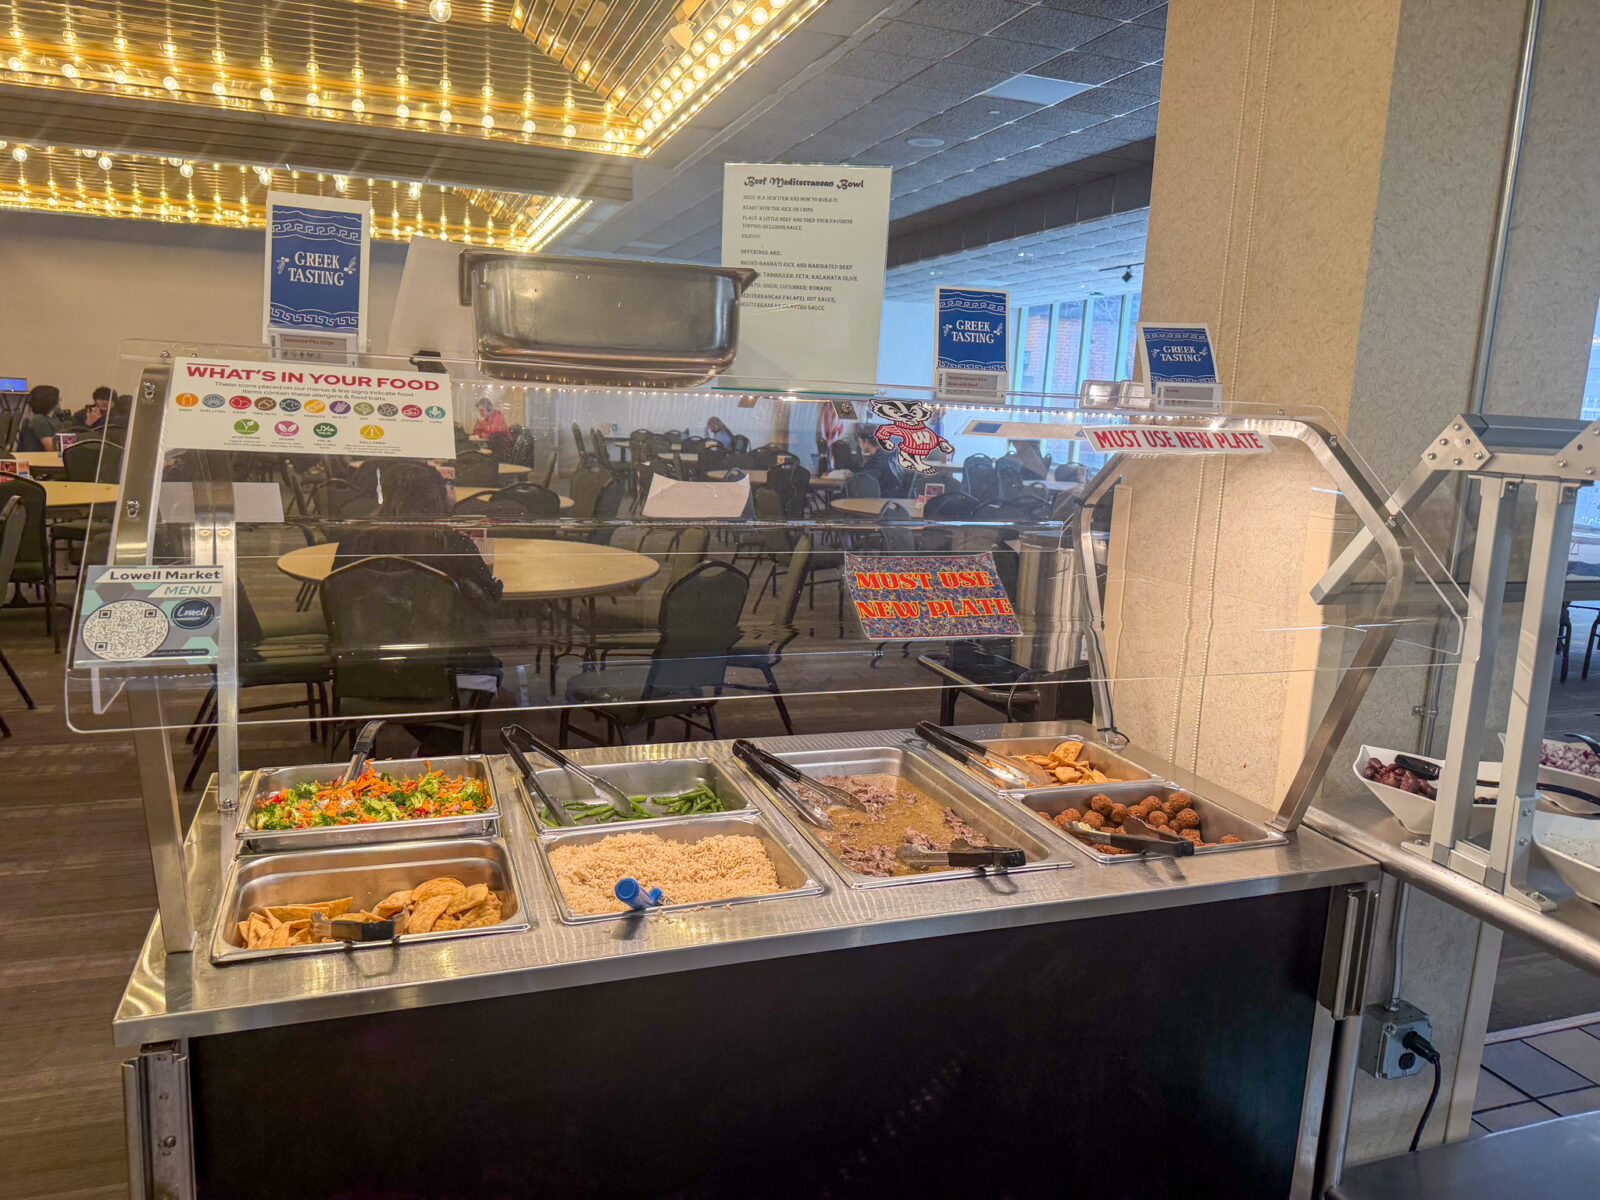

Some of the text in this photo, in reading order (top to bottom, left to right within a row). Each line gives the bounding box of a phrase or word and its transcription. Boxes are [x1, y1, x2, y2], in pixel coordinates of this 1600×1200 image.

[744, 176, 864, 190] Beef Mediterranean Bowl
[294, 251, 340, 269] GREEK
[288, 268, 345, 287] TASTING
[956, 320, 990, 332] GREEK
[951, 331, 995, 344] TASTING
[1163, 346, 1197, 354] GREEK
[1160, 353, 1202, 362] TASTING
[187, 366, 439, 391] WHAT'S IN YOUR FOOD
[912, 431, 931, 445] W
[1093, 430, 1264, 449] MUST USE NEW PLATE
[110, 570, 220, 580] Lowell Market
[855, 571, 993, 590] MUST USE
[164, 585, 212, 595] MENU
[178, 606, 209, 617] Lowell
[855, 598, 1013, 619] NEW PLATE
